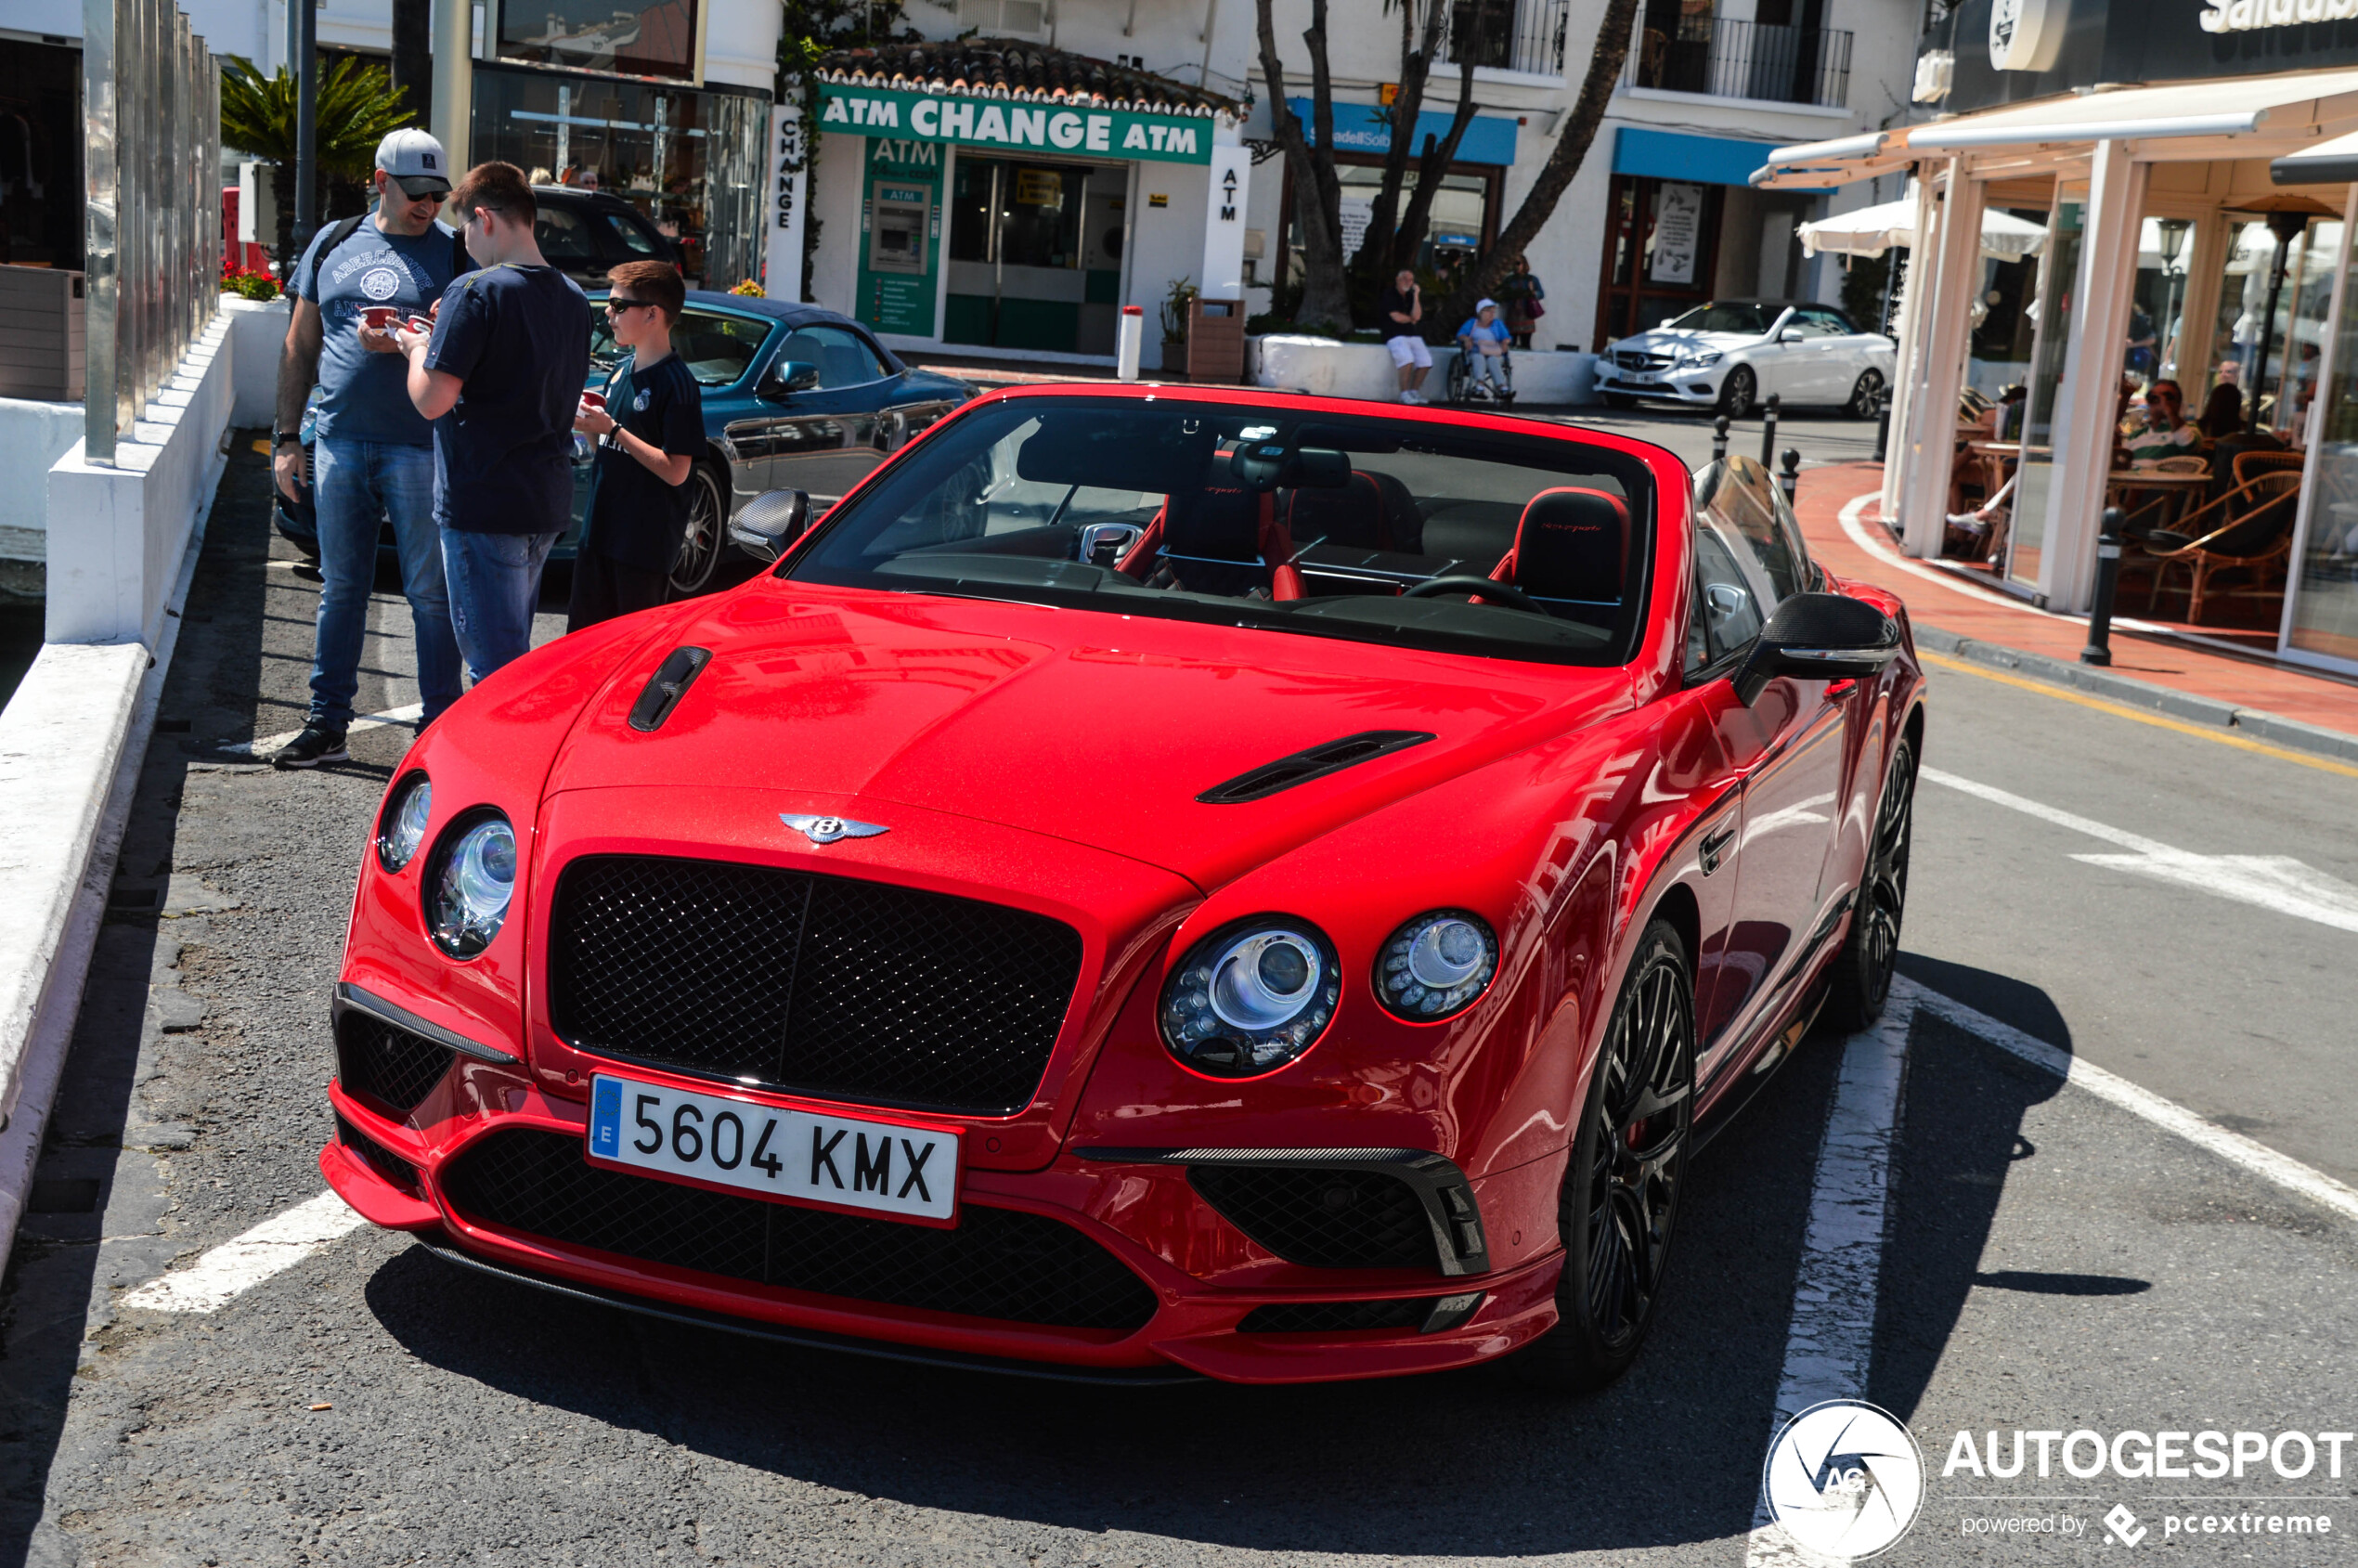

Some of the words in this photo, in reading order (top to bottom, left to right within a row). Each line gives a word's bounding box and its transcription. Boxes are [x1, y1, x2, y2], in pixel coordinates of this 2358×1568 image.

[823, 97, 899, 128] ATM
[910, 99, 1112, 152] CHANGE
[1121, 123, 1198, 155] ATM
[778, 120, 797, 228] CHANGE
[873, 137, 937, 166] ATM
[889, 190, 915, 201] ATM
[1221, 168, 1237, 222] ATM
[331, 250, 434, 292] ABERCROMBIE
[601, 1125, 612, 1143] E
[632, 1094, 784, 1179] 5604
[810, 1125, 937, 1203] KMX
